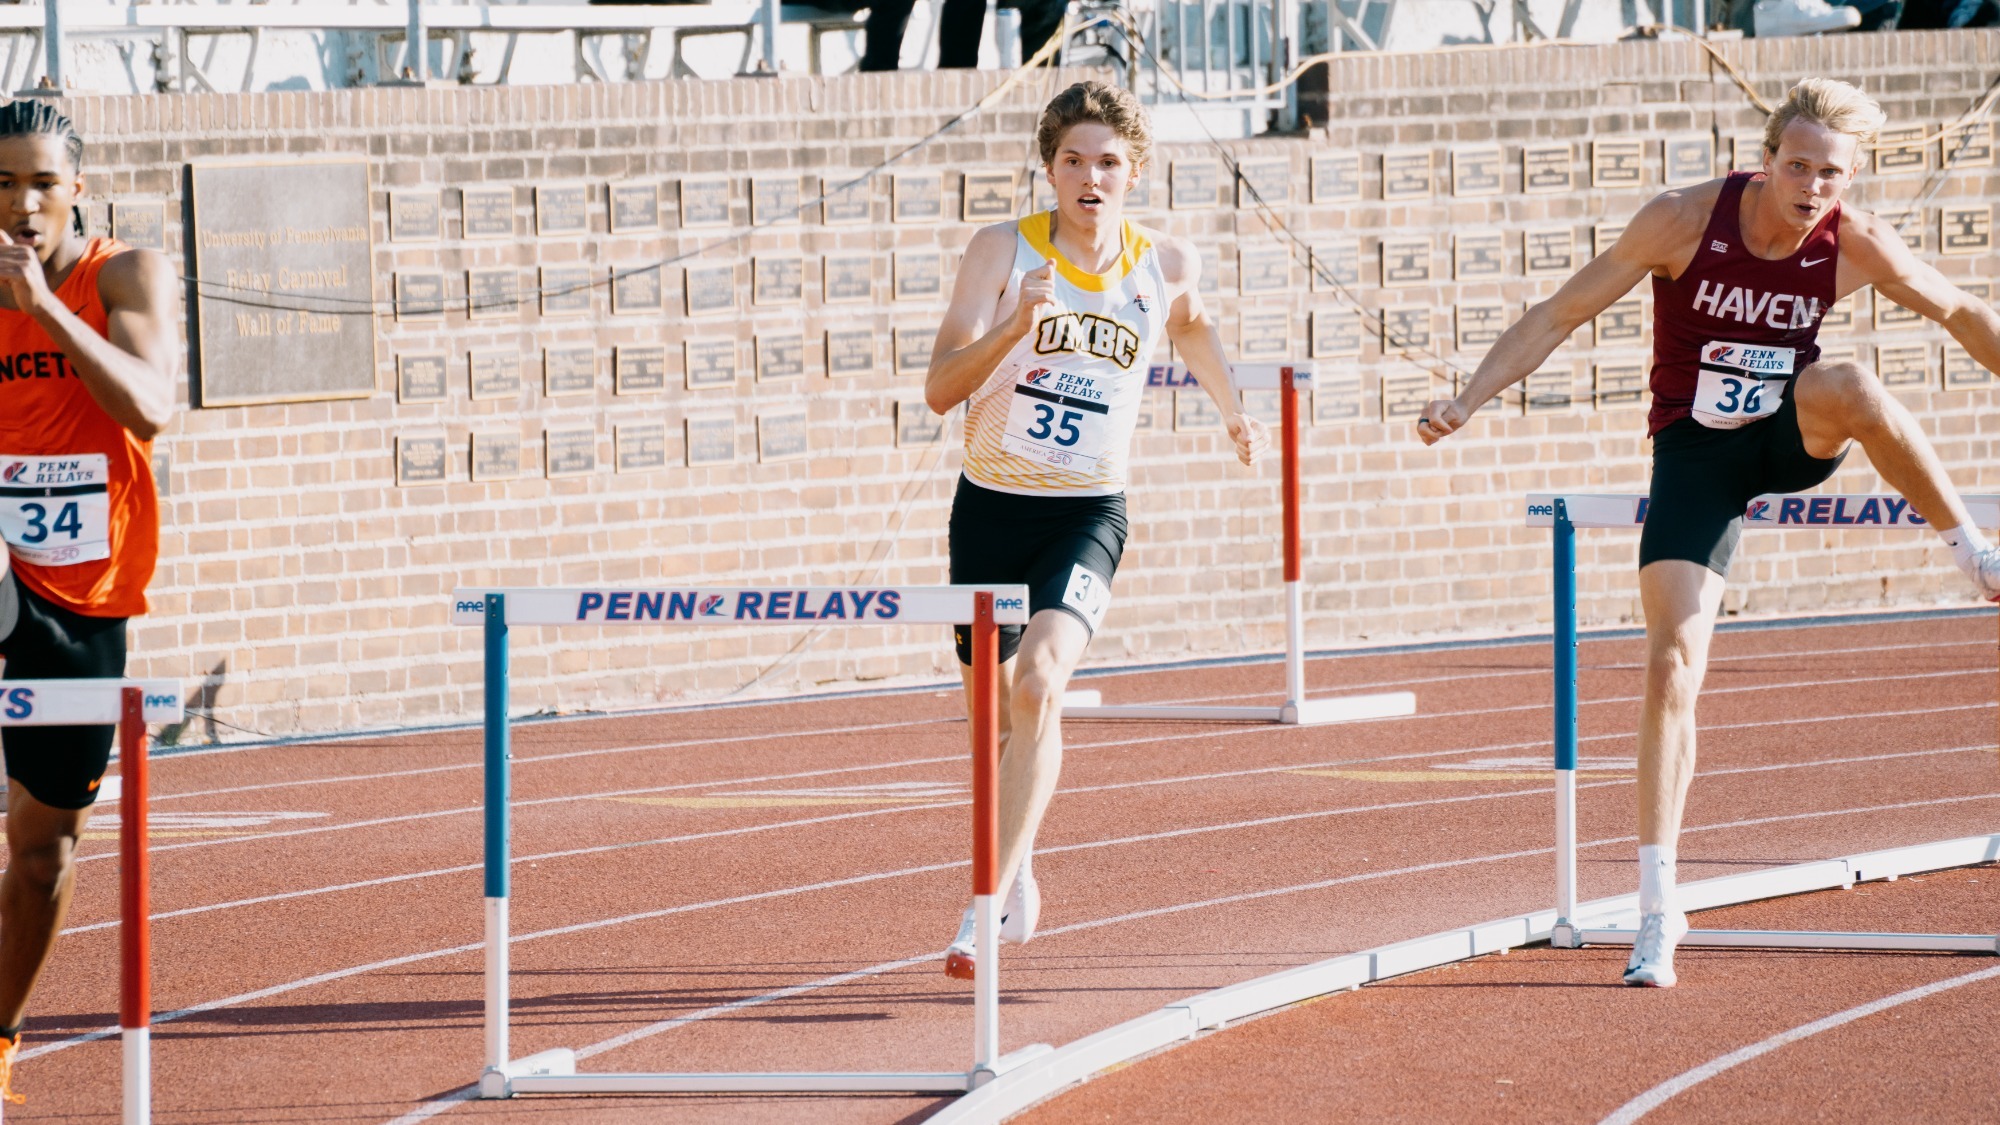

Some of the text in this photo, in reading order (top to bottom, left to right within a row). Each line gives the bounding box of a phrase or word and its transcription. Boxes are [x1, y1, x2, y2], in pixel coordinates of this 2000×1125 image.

[202, 225, 367, 249] University of Pennsylvania
[226, 265, 348, 296] Relay Carnival
[1692, 279, 1819, 330] HAVEN
[236, 310, 341, 337] Wall of Fame
[1034, 312, 1138, 369] UMBC
[0, 352, 80, 382] NCET
[1738, 358, 1784, 370] RELAYS
[1742, 349, 1776, 360] PENN
[1058, 373, 1095, 388] PENN
[1146, 366, 1200, 387] ELA
[1054, 382, 1103, 400] RELAYS
[1715, 378, 1766, 413] 36
[1026, 403, 1084, 447] 35
[35, 470, 94, 483] RELAYS
[37, 461, 81, 472] PENN
[19, 501, 83, 544] 34
[576, 590, 901, 621] PENN RELAYS
